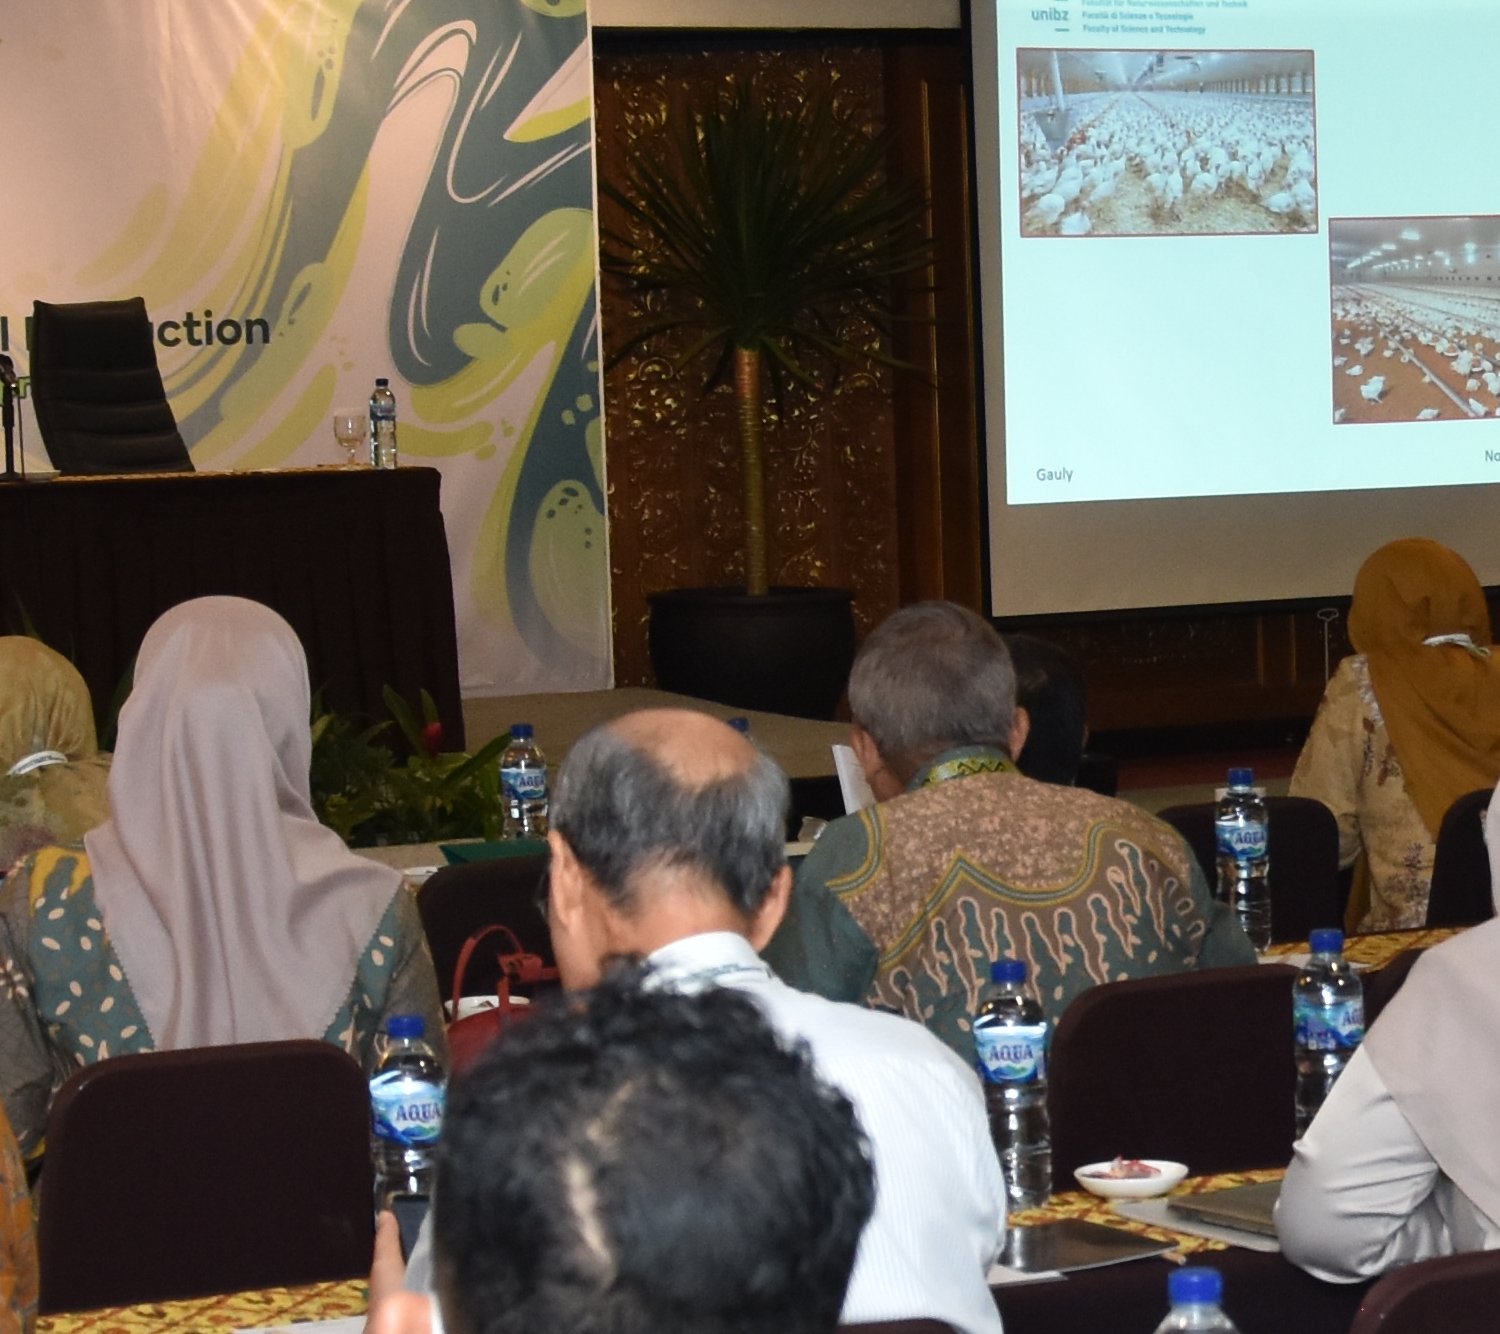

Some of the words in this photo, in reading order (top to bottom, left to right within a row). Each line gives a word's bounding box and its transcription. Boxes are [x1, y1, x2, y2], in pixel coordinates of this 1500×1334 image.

[1031, 7, 1069, 22] unibz
[149, 309, 270, 348] ction
[1036, 467, 1073, 482] Gauly
[1235, 832, 1266, 845] AQUA
[989, 1044, 1034, 1062] AQUA
